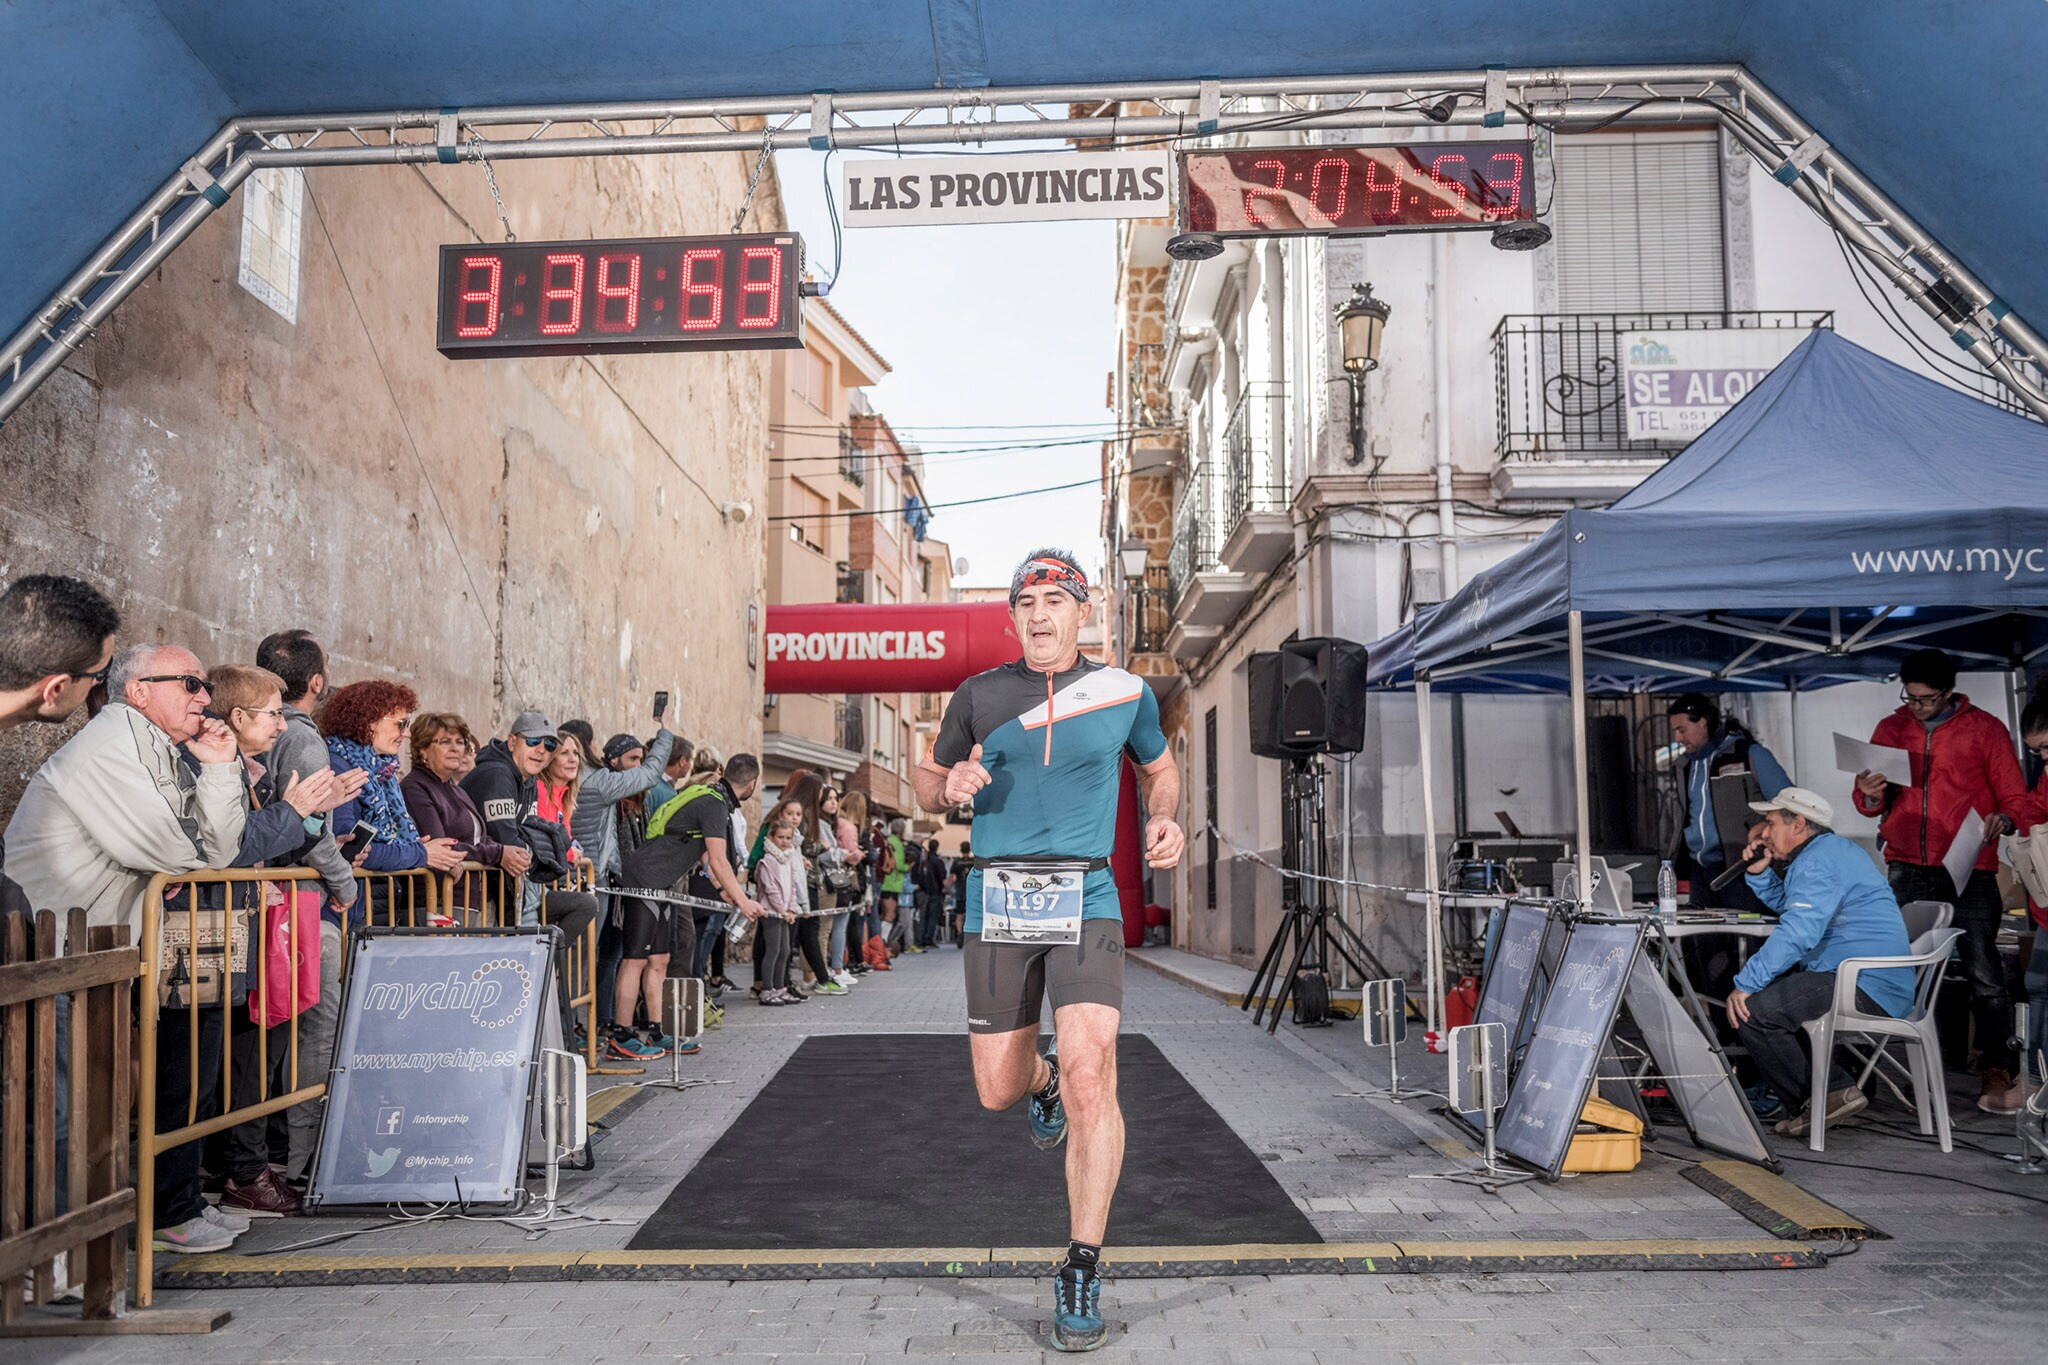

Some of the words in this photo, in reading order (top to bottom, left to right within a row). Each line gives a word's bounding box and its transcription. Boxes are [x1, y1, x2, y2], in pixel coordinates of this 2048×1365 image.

[848, 175, 921, 211] LAS
[929, 166, 1165, 209] PROVINCIAS
[1633, 371, 1671, 405] SE
[1851, 545, 2048, 581] www.myc
[766, 630, 946, 661] PROVINCIAS
[1006, 891, 1060, 912] 1197
[363, 971, 503, 1020] mychip
[352, 1047, 517, 1073] www.mychip.es
[412, 1113, 469, 1125] /infomychip
[404, 1154, 474, 1169] @Mychip_Info
